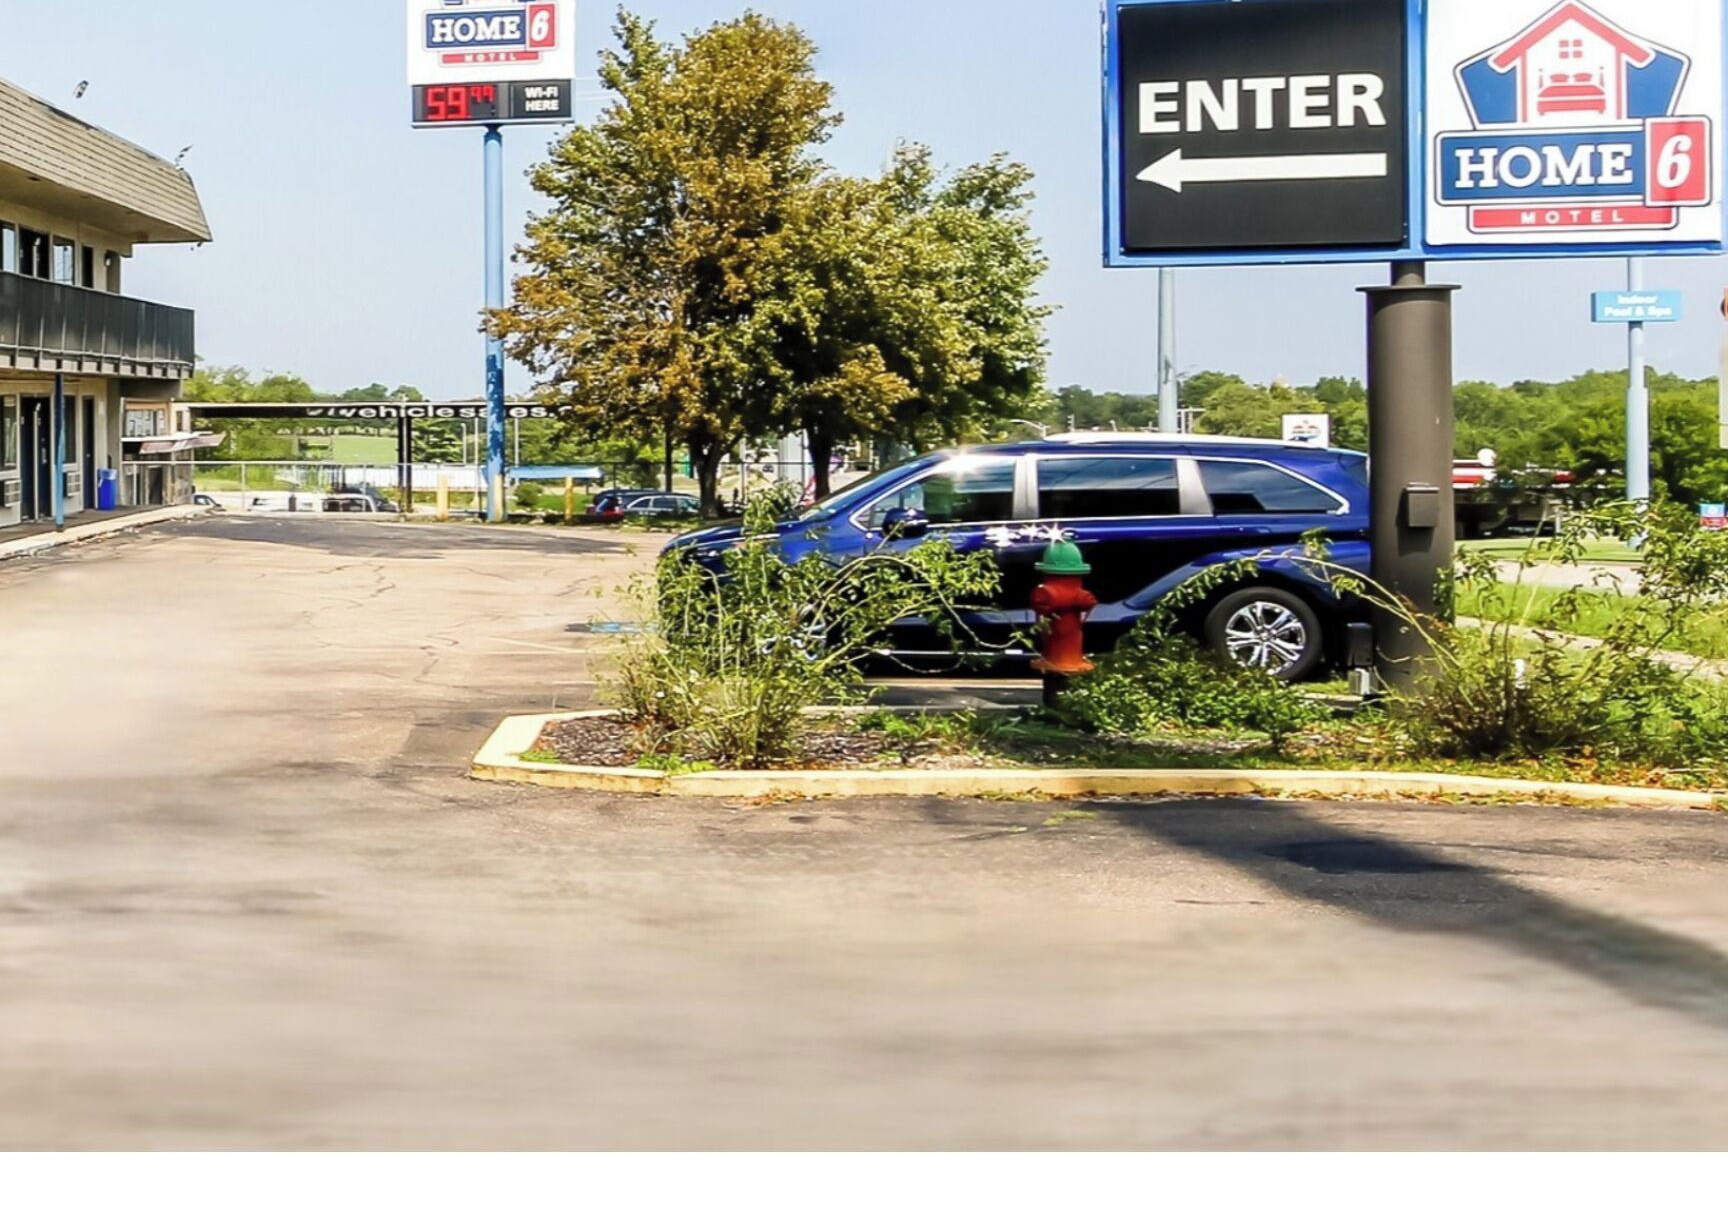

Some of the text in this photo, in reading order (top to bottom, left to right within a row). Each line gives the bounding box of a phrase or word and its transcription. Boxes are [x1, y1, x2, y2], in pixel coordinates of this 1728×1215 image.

[431, 10, 551, 43] HOME 6
[464, 52, 517, 63] MOTEL
[524, 86, 558, 99] WI-FI
[525, 99, 560, 112] HERE
[1138, 73, 1387, 134] ENTER
[1454, 134, 1693, 189] HOME 6
[1520, 210, 1625, 225] MOTEL
